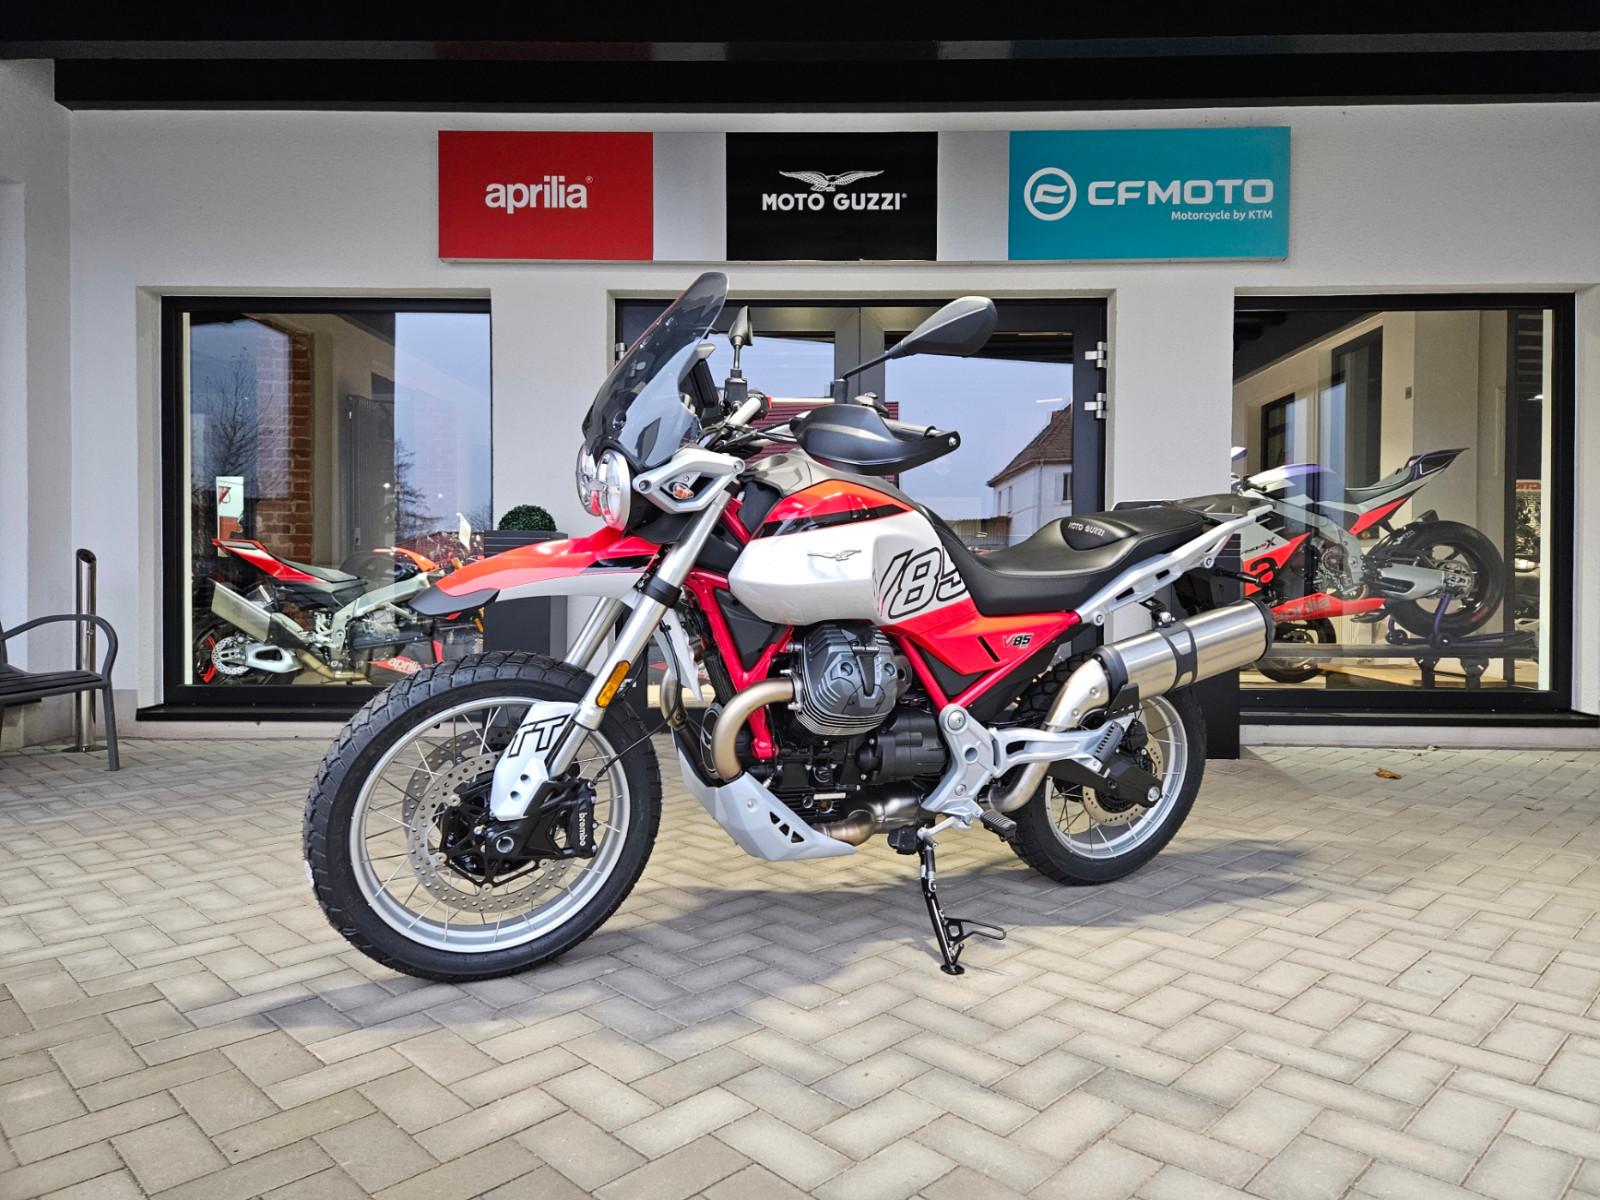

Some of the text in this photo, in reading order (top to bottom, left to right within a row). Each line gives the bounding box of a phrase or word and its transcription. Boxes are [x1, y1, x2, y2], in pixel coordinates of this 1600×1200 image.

[485, 175, 587, 214] aprilia
[762, 192, 901, 211] MOTO GUZZI
[1087, 178, 1274, 206] CFMOTO
[1171, 209, 1273, 222] Motorcycle by KTM
[1002, 633, 1034, 649] V85
[507, 713, 571, 758] TT
[578, 811, 588, 847] brembo
